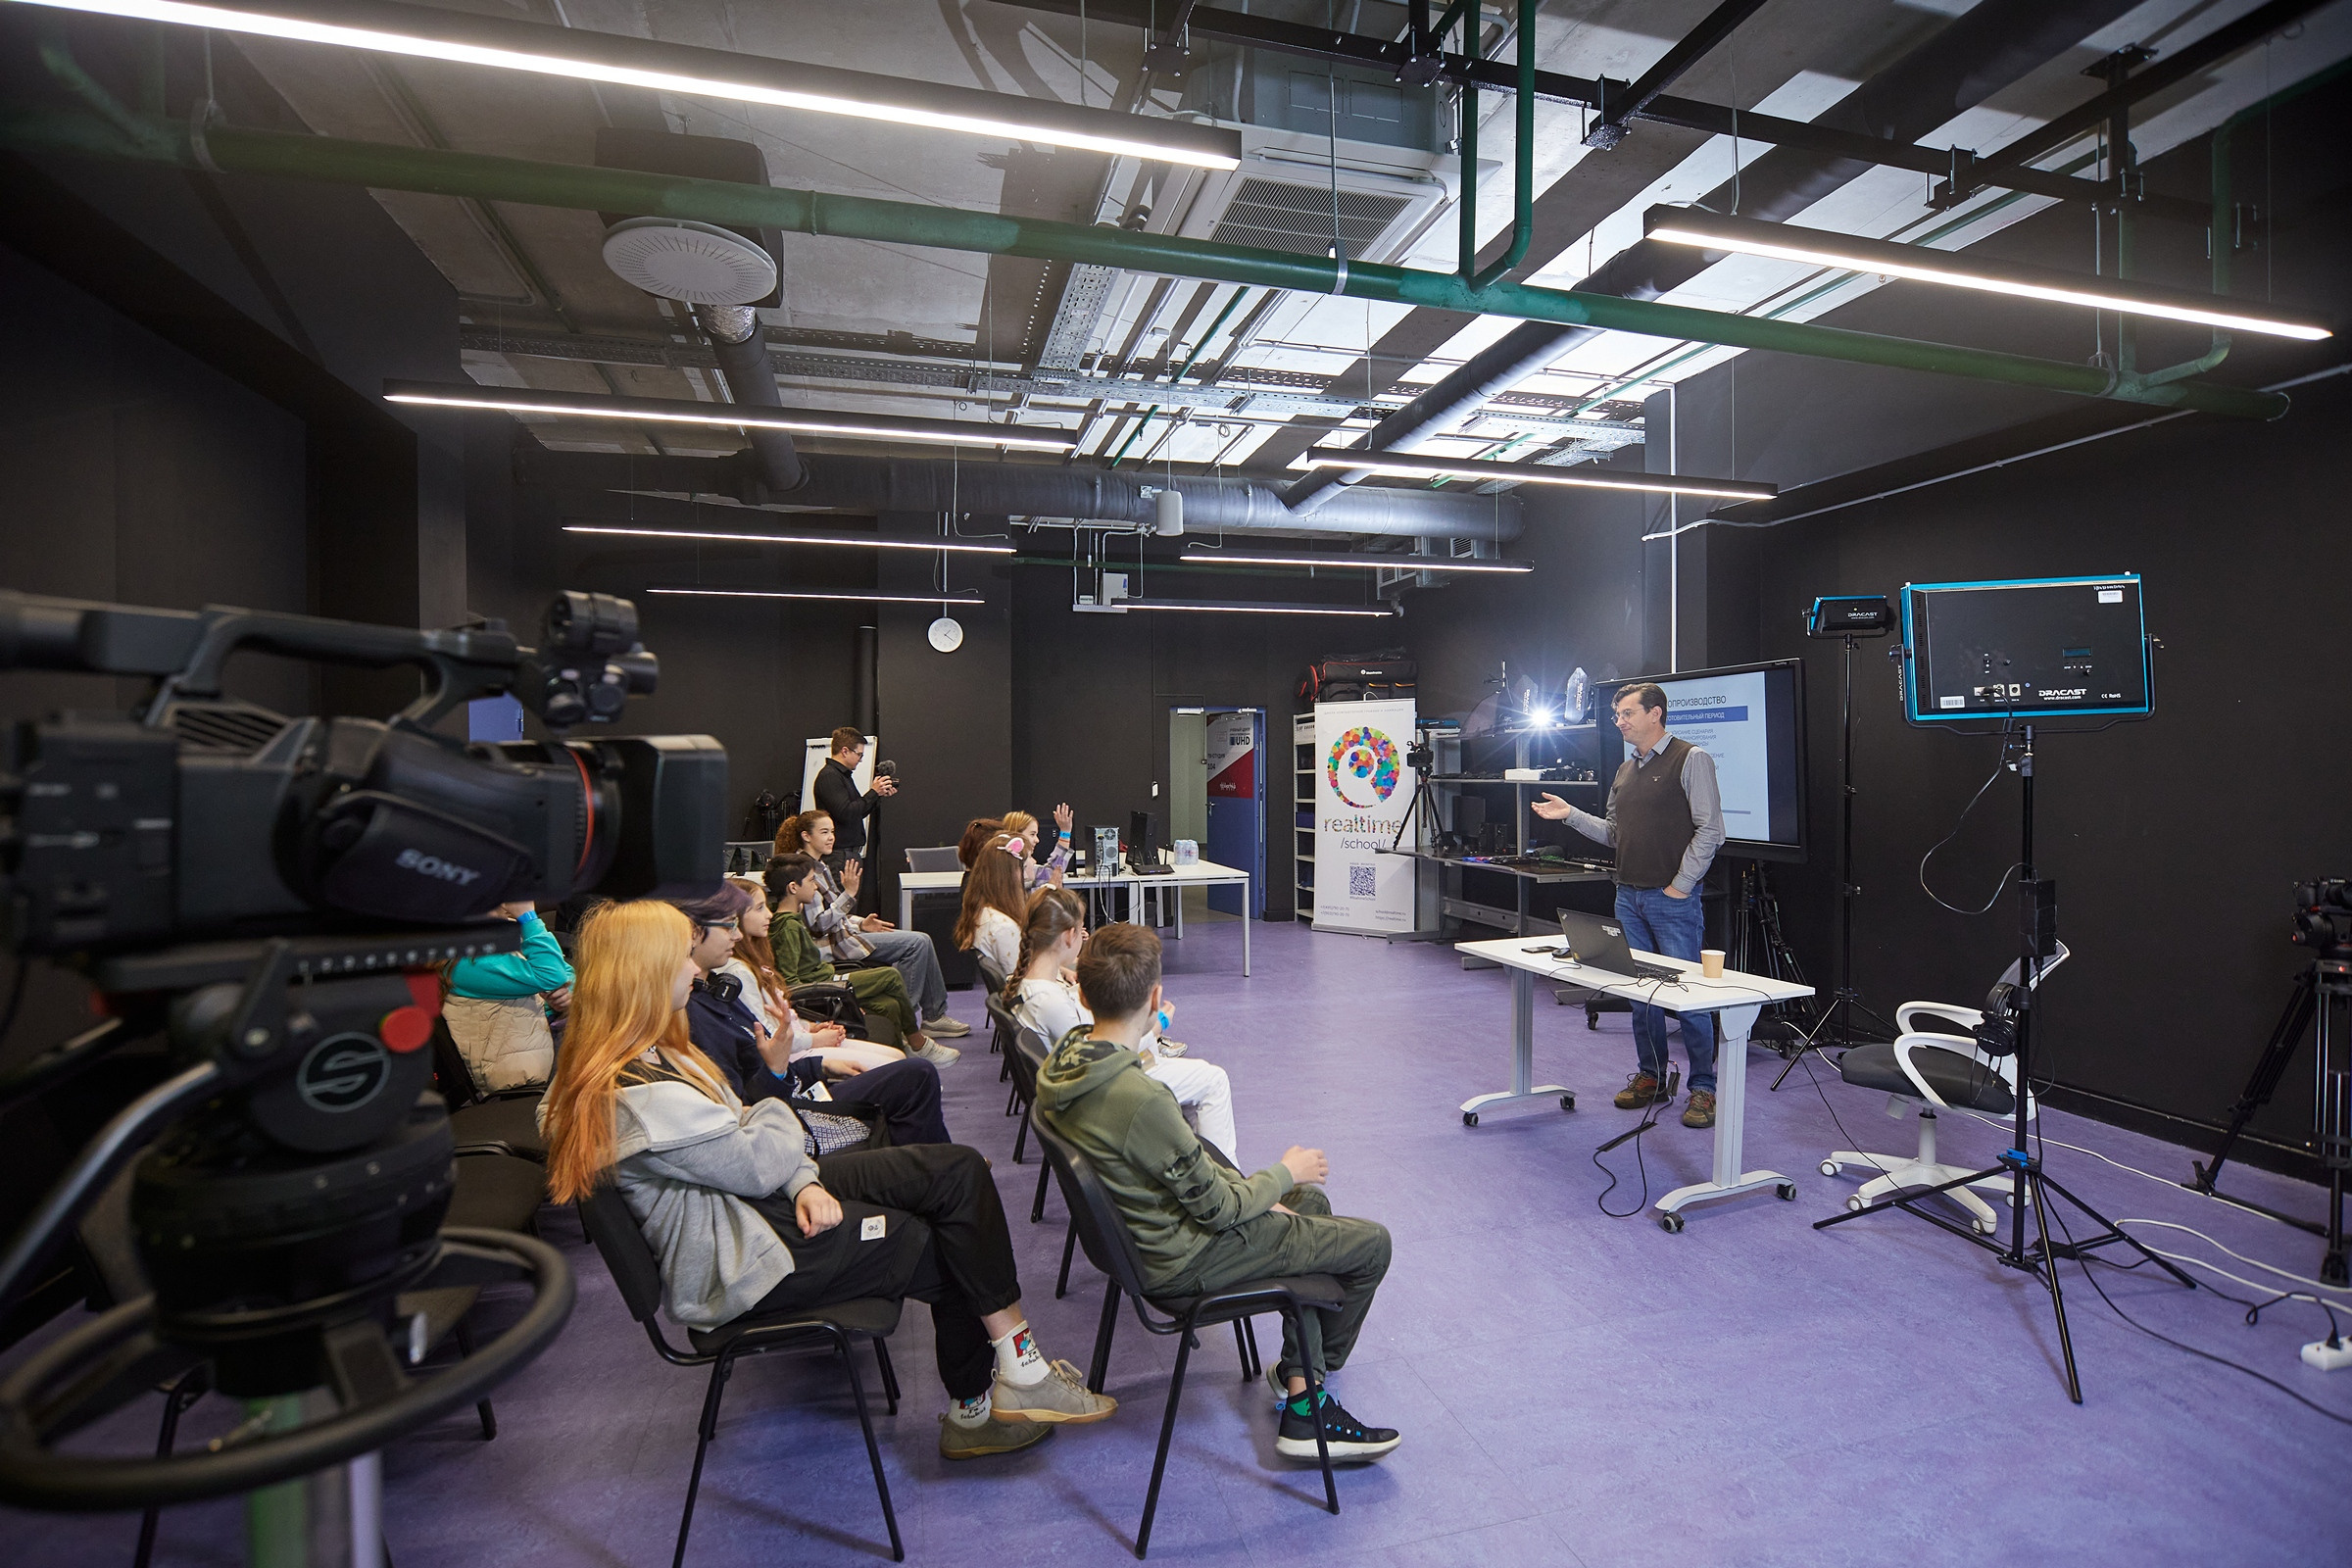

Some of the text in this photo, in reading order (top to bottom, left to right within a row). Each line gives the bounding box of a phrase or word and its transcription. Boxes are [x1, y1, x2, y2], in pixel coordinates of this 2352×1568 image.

[2037, 688, 2087, 697] DRACAST
[1667, 695, 1727, 709] ОПРОИЗВОДСТВО
[1236, 736, 1250, 746] UHD
[1324, 814, 1402, 834] realtime
[395, 848, 482, 886] SONY
